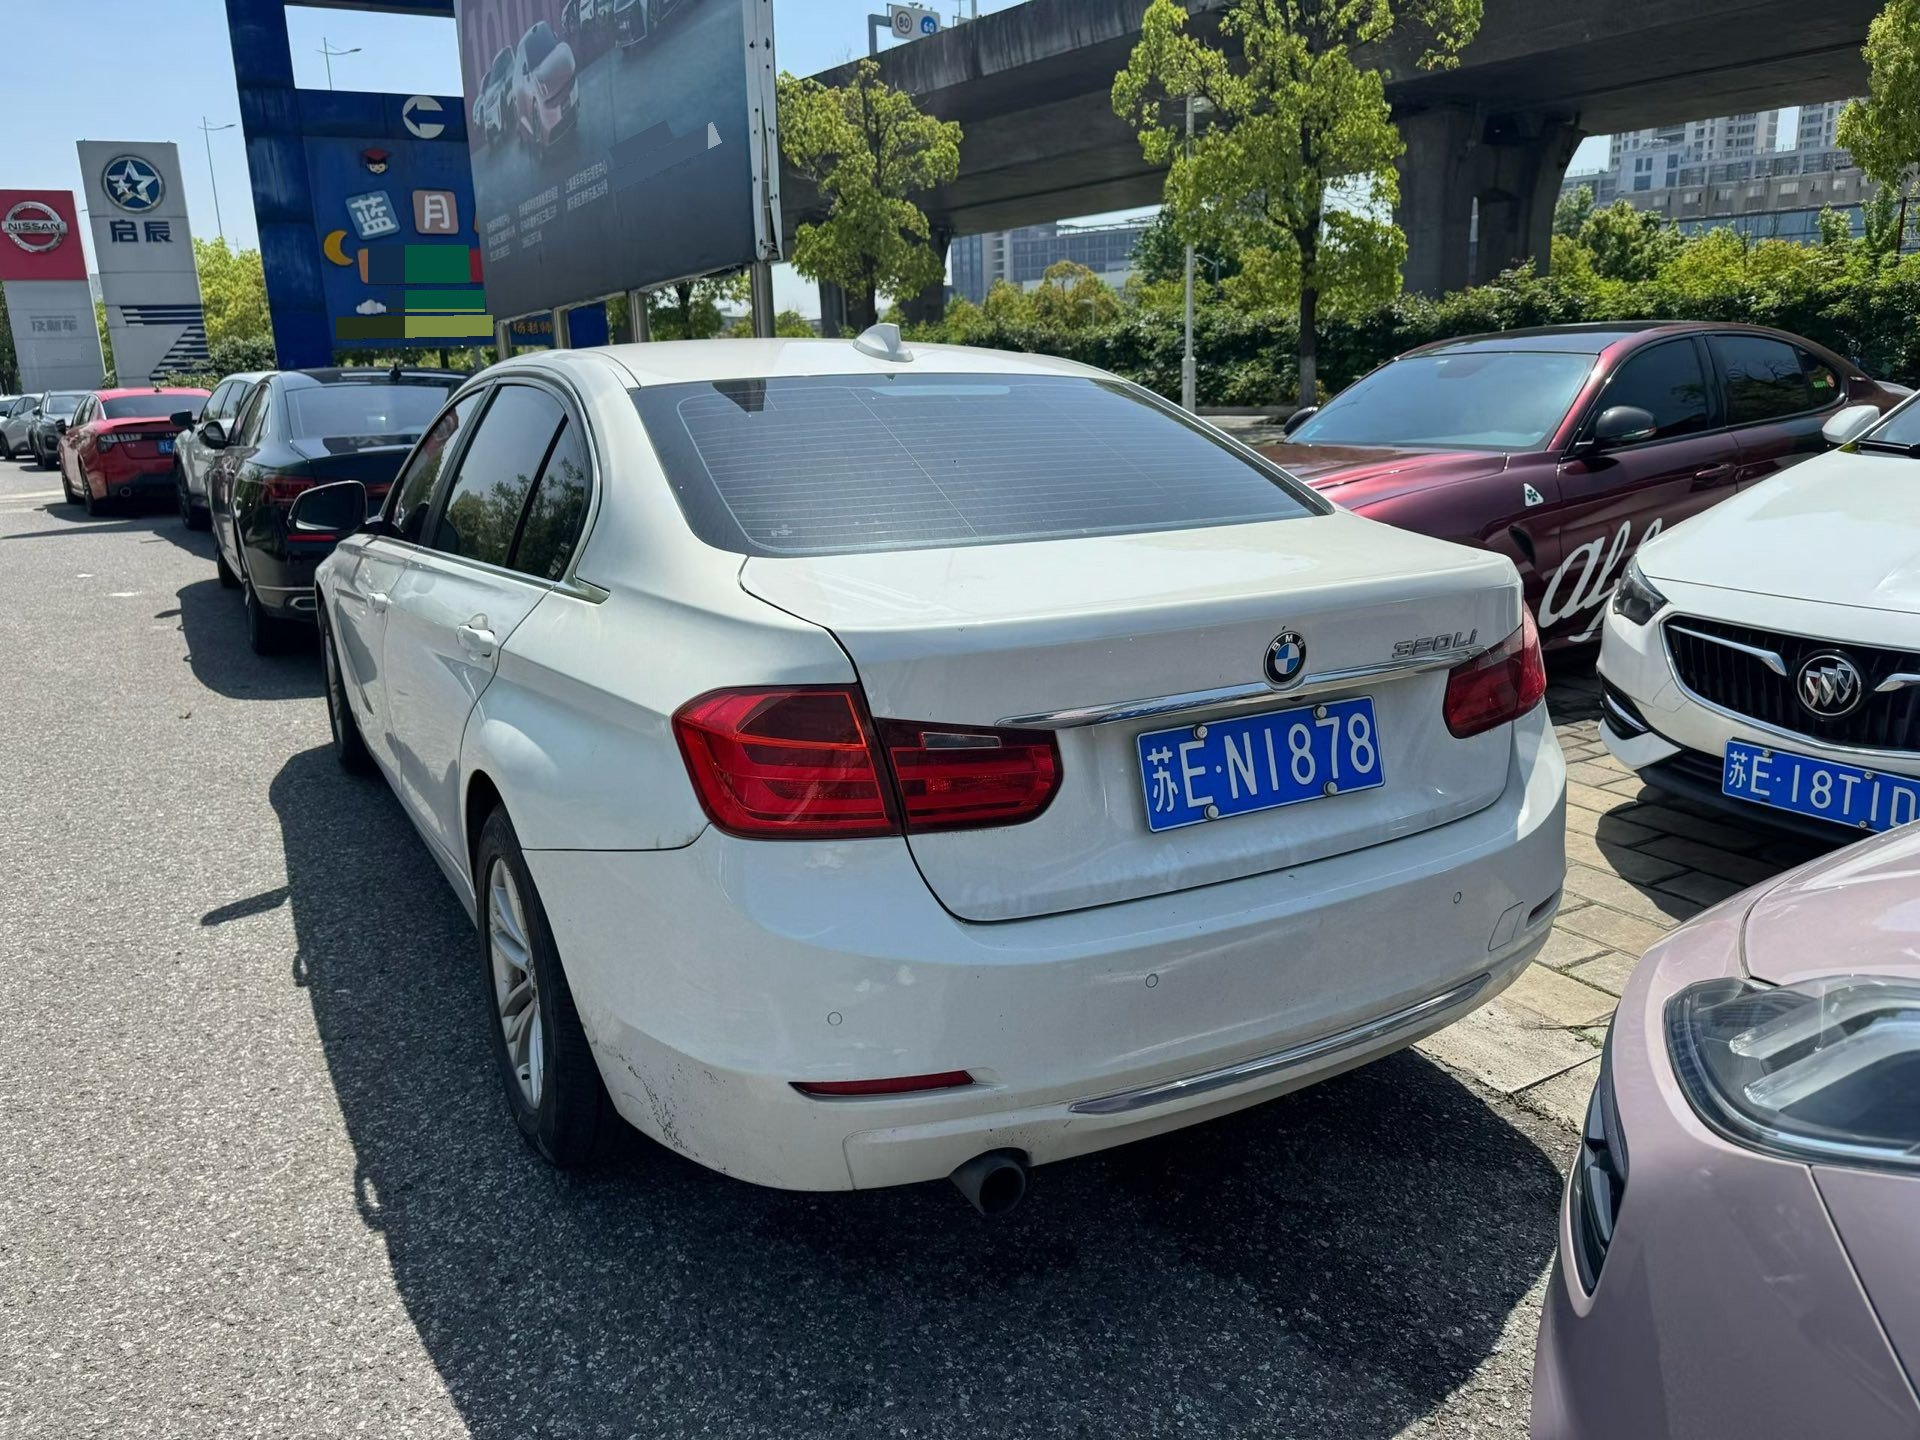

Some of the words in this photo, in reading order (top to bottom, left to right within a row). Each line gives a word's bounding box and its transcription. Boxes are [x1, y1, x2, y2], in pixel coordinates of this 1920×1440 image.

[923, 21, 935, 33] 60
[8, 222, 61, 231] NISSAN
[109, 219, 173, 243] 启辰
